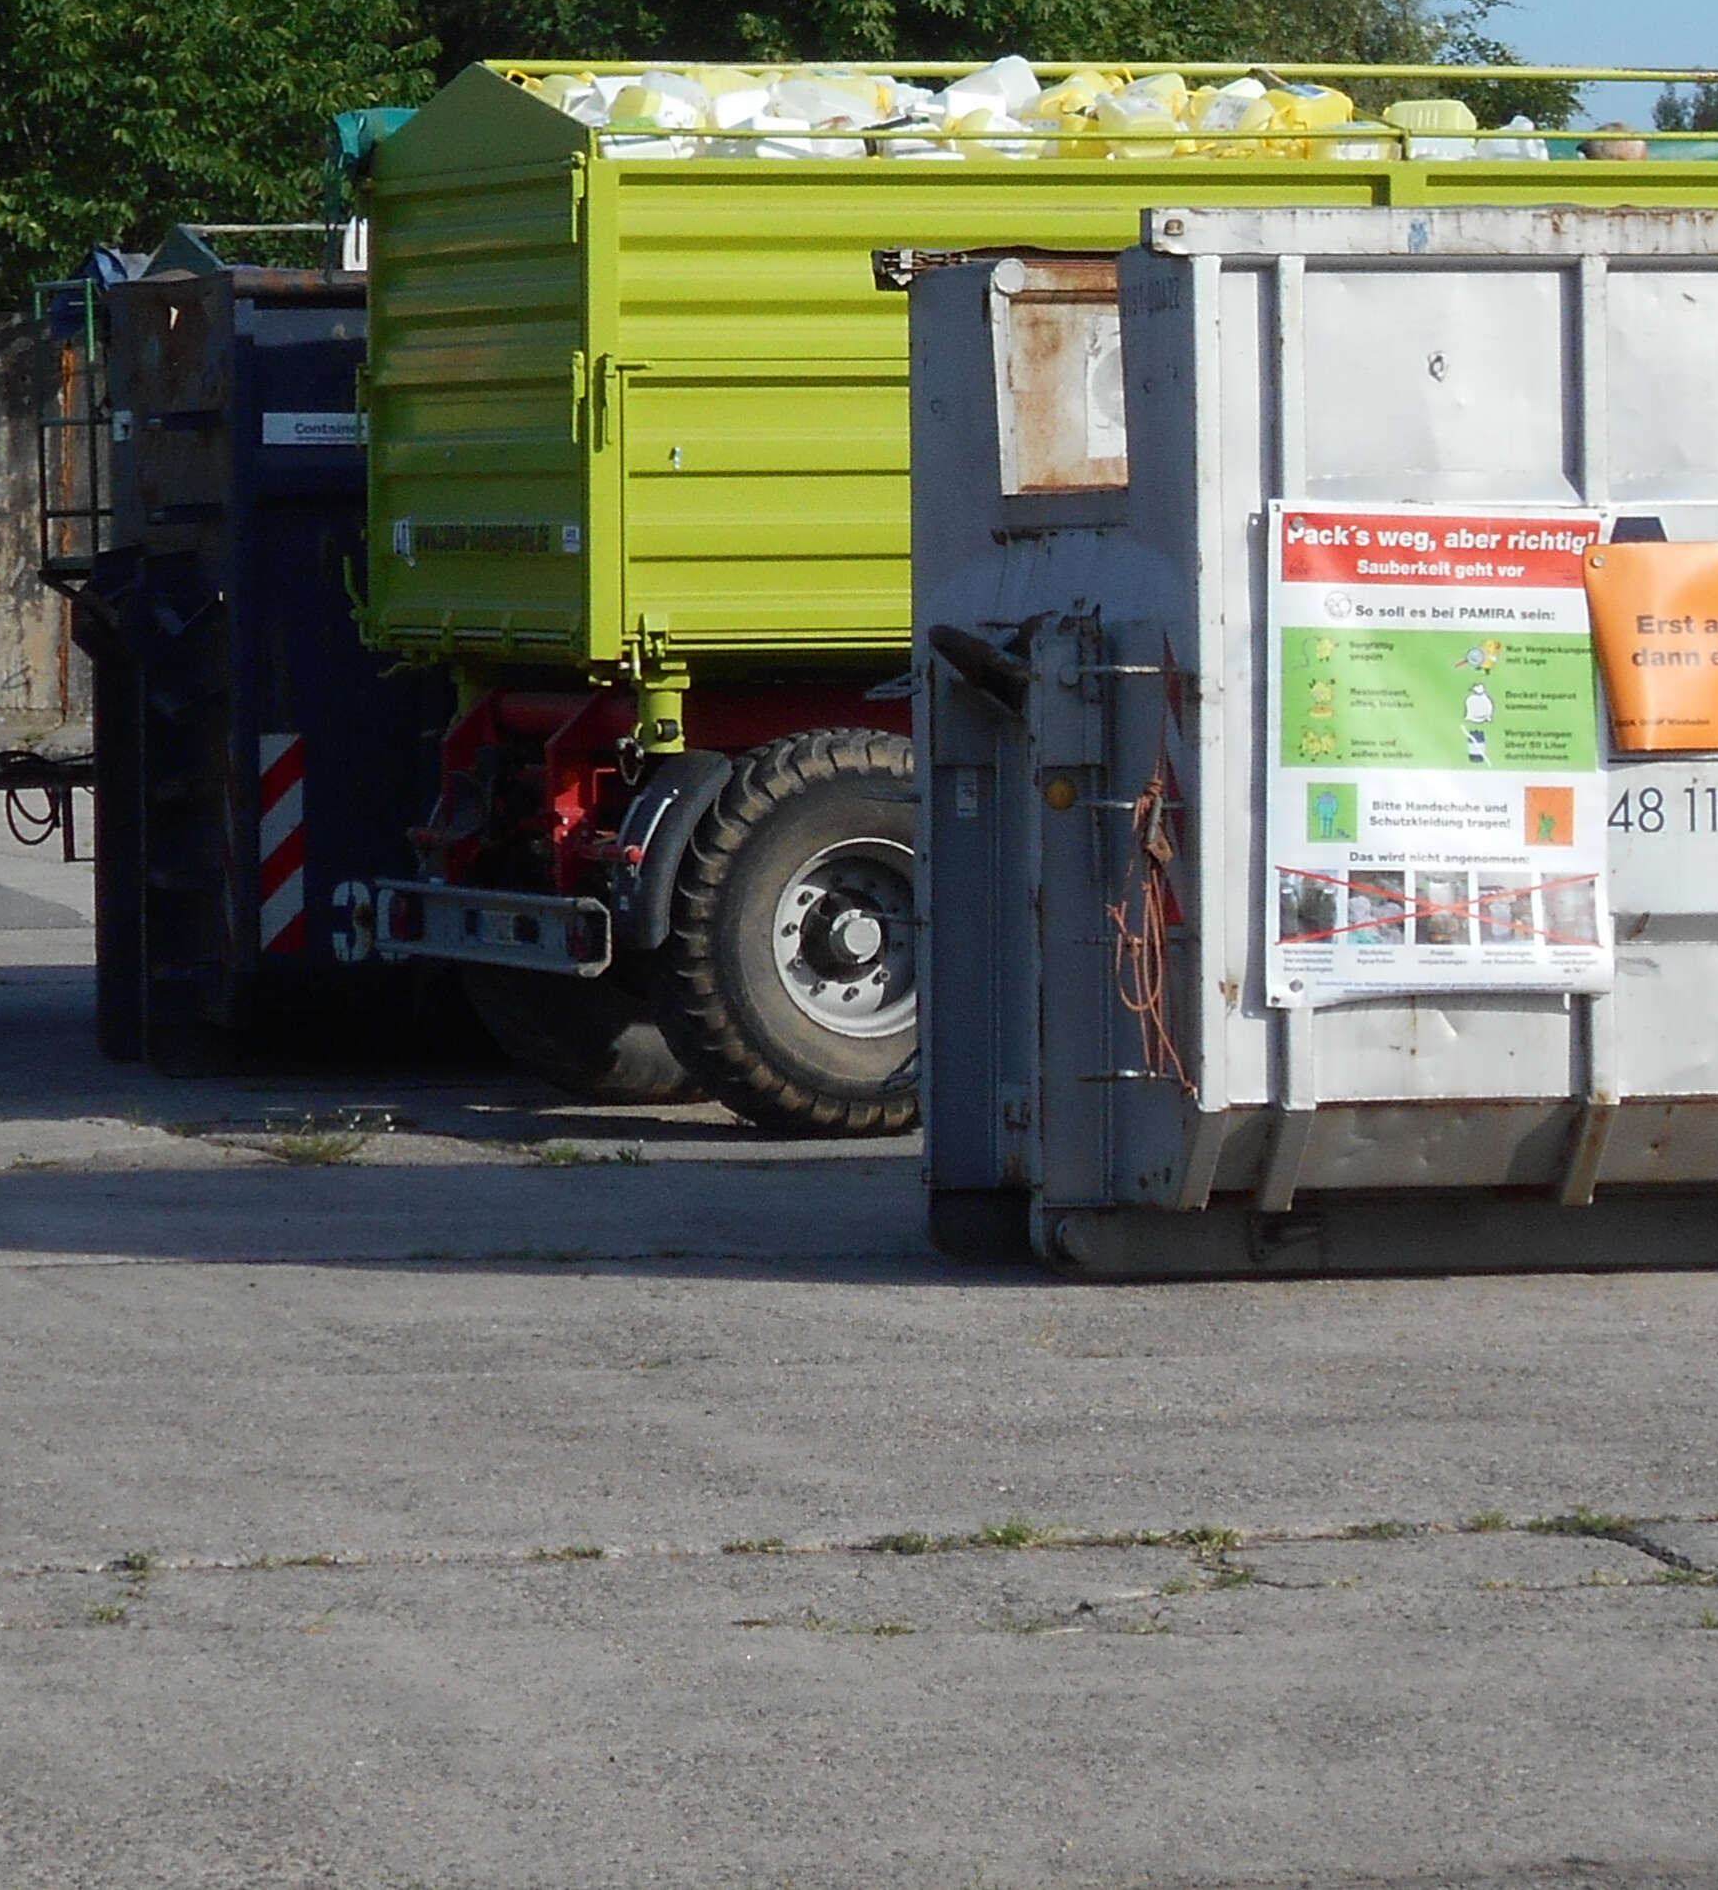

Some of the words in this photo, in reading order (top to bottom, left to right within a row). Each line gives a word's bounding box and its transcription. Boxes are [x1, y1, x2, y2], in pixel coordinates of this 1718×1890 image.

[1377, 528, 1436, 551] weg,
[1444, 528, 1500, 550] aber
[1356, 558, 1451, 577] Sauberkeit
[1455, 562, 1493, 580] geht
[1497, 565, 1525, 578] vor
[1356, 605, 1374, 619] So
[1378, 605, 1405, 619] soll
[1410, 608, 1427, 620] es
[1431, 605, 1454, 619] bei
[1459, 606, 1515, 620] PAMIRA
[1520, 608, 1556, 621] sein:
[1636, 614, 1695, 635] Erst
[1632, 647, 1700, 667] dann
[1372, 801, 1401, 811] Bitte
[1406, 801, 1480, 813] Handschuhe
[1485, 802, 1508, 813] und
[1369, 816, 1463, 829] Schutzkleidung
[1467, 817, 1510, 829] tragen!
[1349, 852, 1374, 862] Das
[1378, 852, 1405, 863] wird
[1409, 852, 1440, 863] nicht
[1444, 854, 1530, 865] angenommen:
